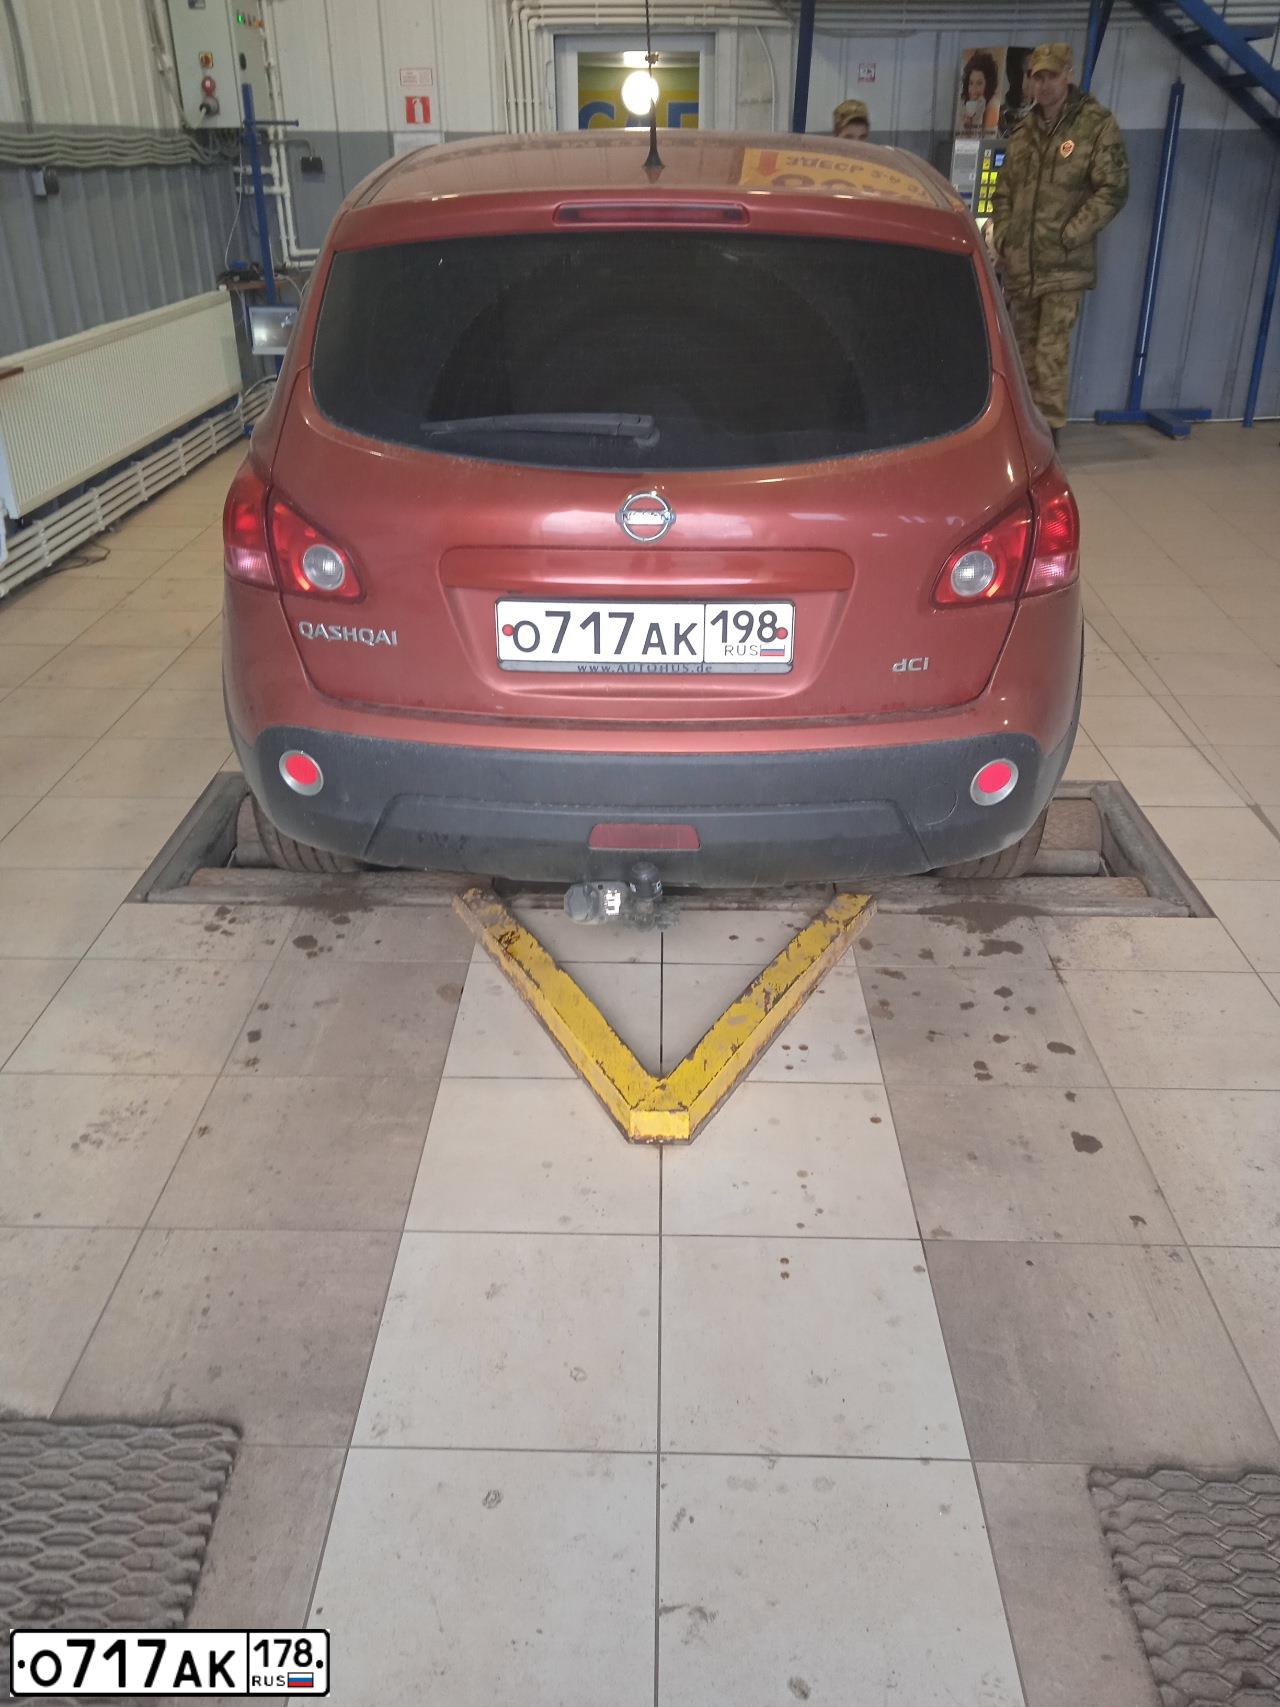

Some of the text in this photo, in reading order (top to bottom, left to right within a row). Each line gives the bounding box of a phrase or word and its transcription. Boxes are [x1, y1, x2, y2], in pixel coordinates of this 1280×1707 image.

[299, 621, 398, 646] QASHQAI
[513, 610, 778, 656] О717АК 198
[724, 644, 759, 657] RUS
